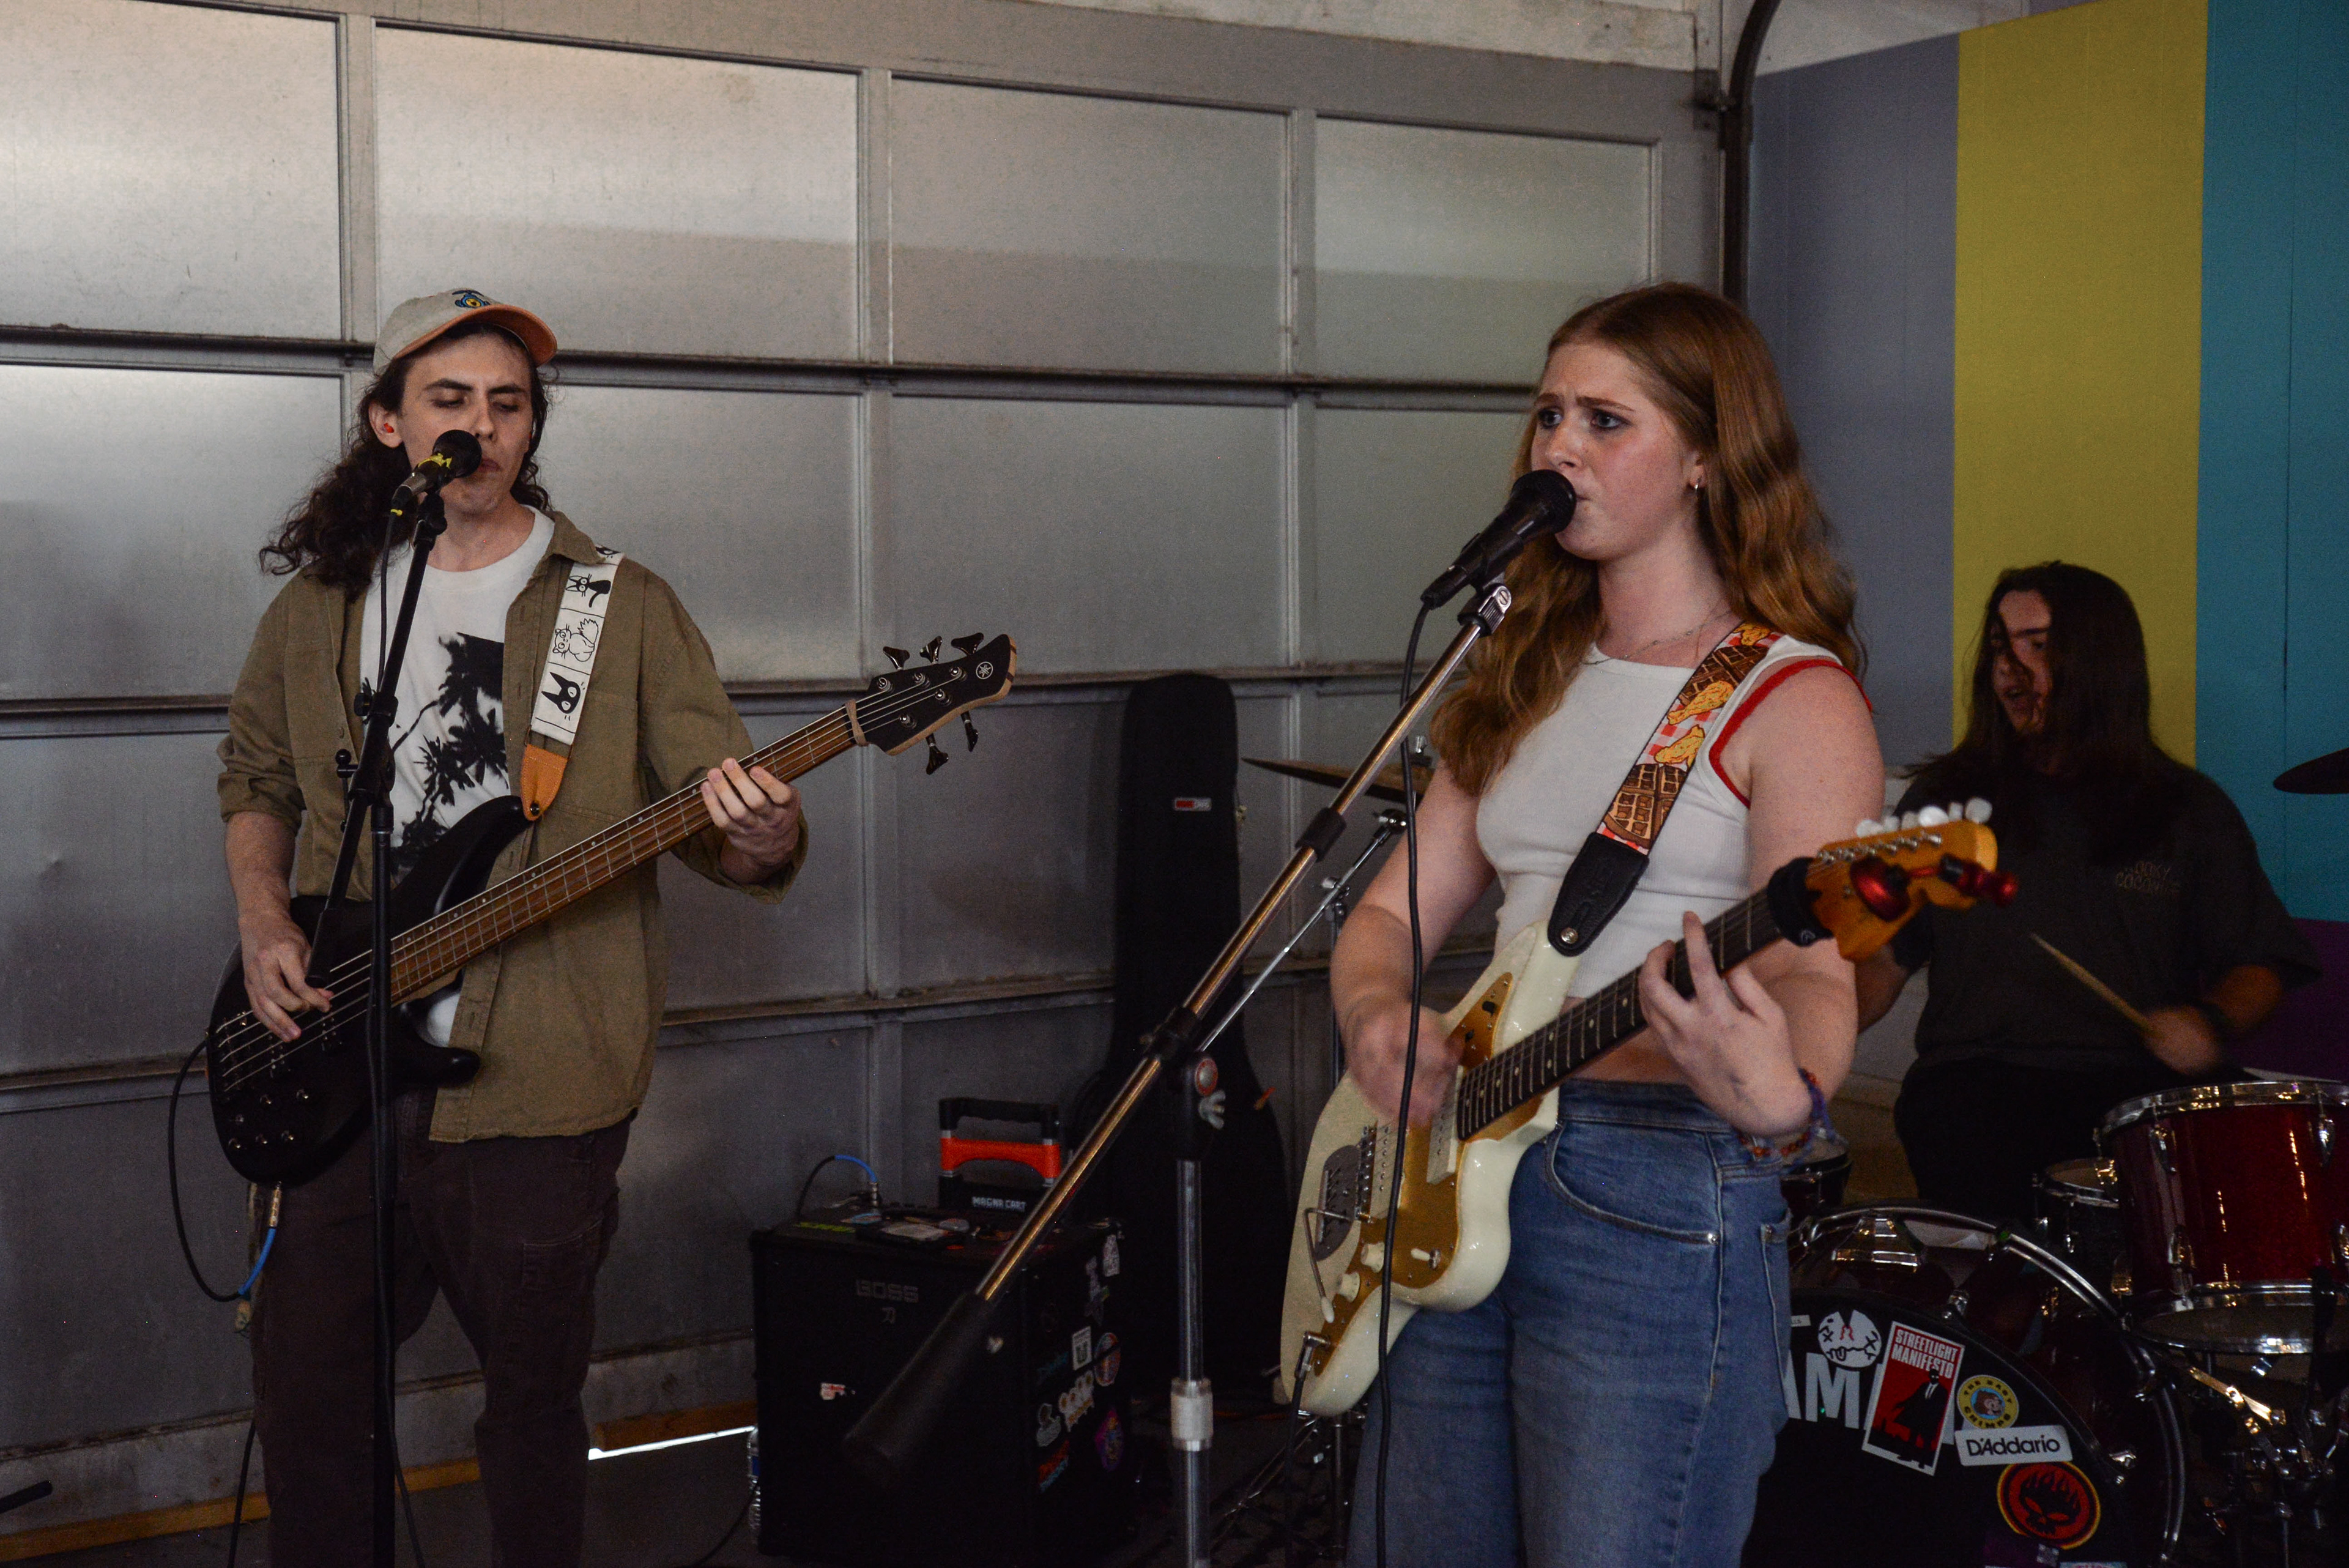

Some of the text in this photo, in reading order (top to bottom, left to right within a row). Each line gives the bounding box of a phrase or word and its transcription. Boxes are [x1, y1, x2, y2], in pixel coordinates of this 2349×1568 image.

[856, 1279, 919, 1304] BOSS
[1895, 1329, 1959, 1363] STREETLIGHT
[1890, 1343, 1956, 1380] MANIFESTO
[1966, 1434, 2060, 1456] D'Addario
